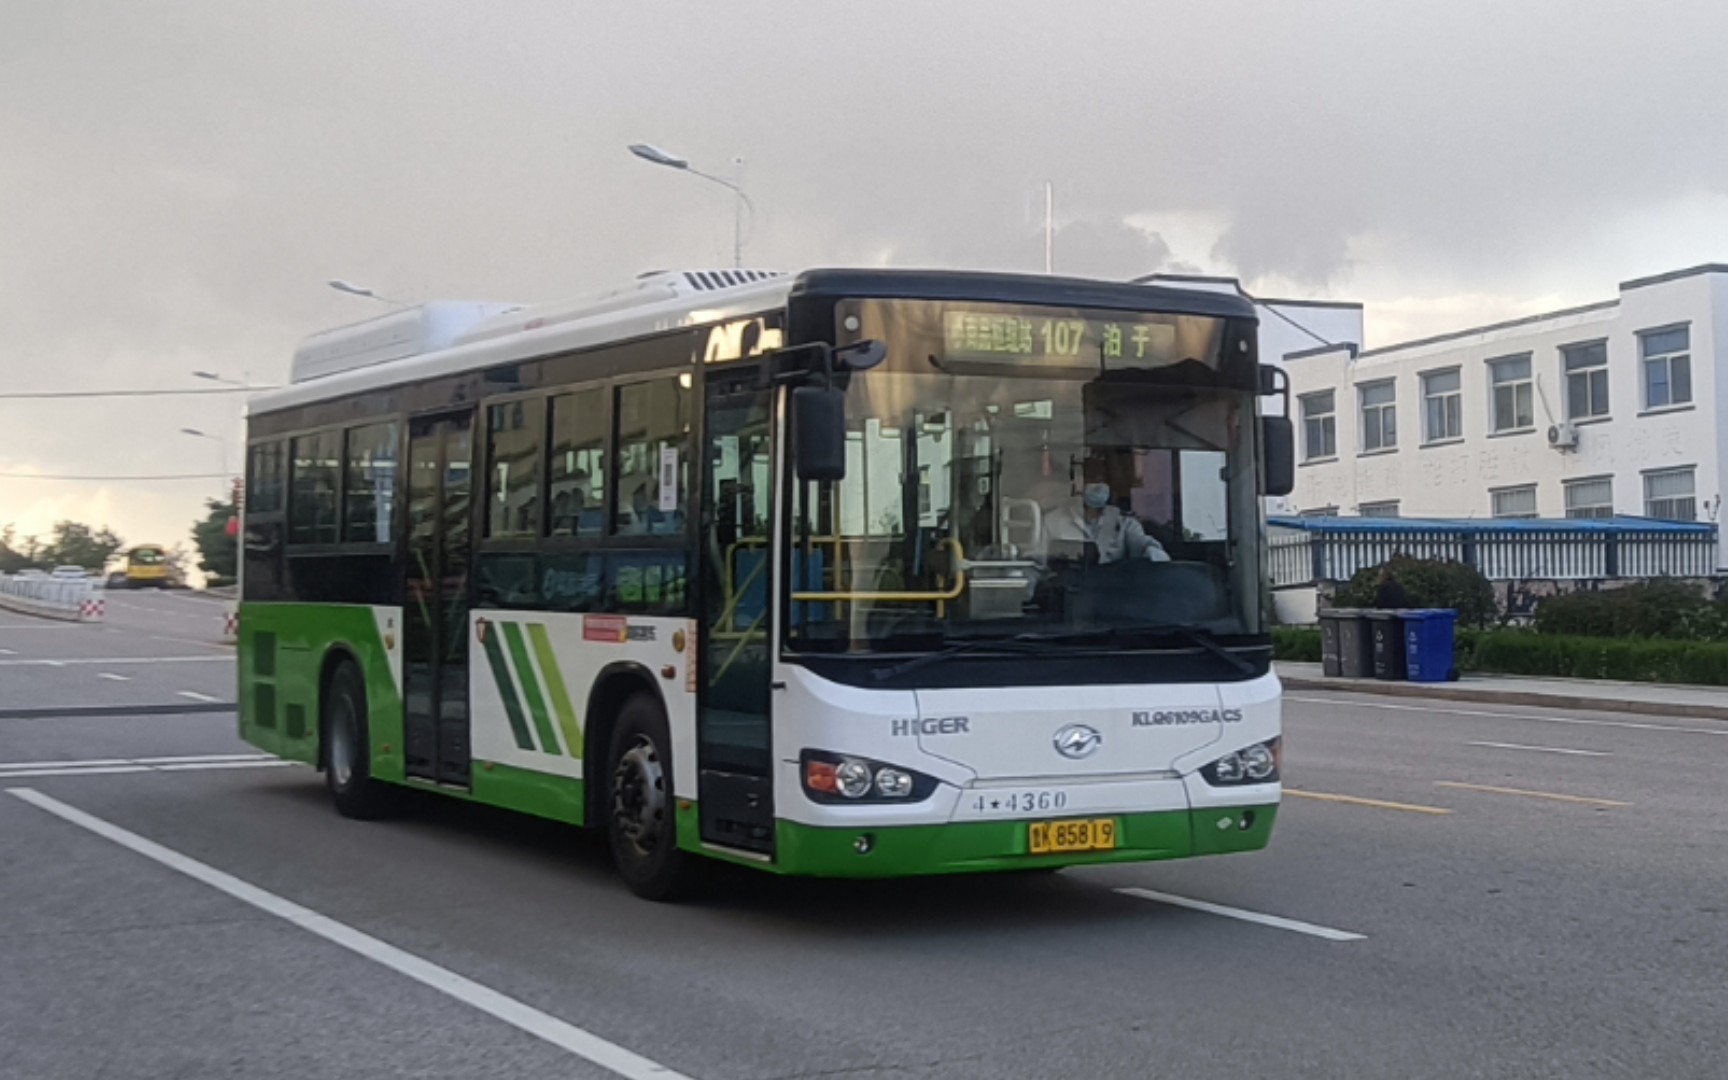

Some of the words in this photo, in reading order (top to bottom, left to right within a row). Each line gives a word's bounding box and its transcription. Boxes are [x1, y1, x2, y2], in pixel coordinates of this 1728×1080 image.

[1041, 320, 1085, 355] 107
[891, 716, 969, 736] HIGER
[1057, 823, 1112, 846] 85819
